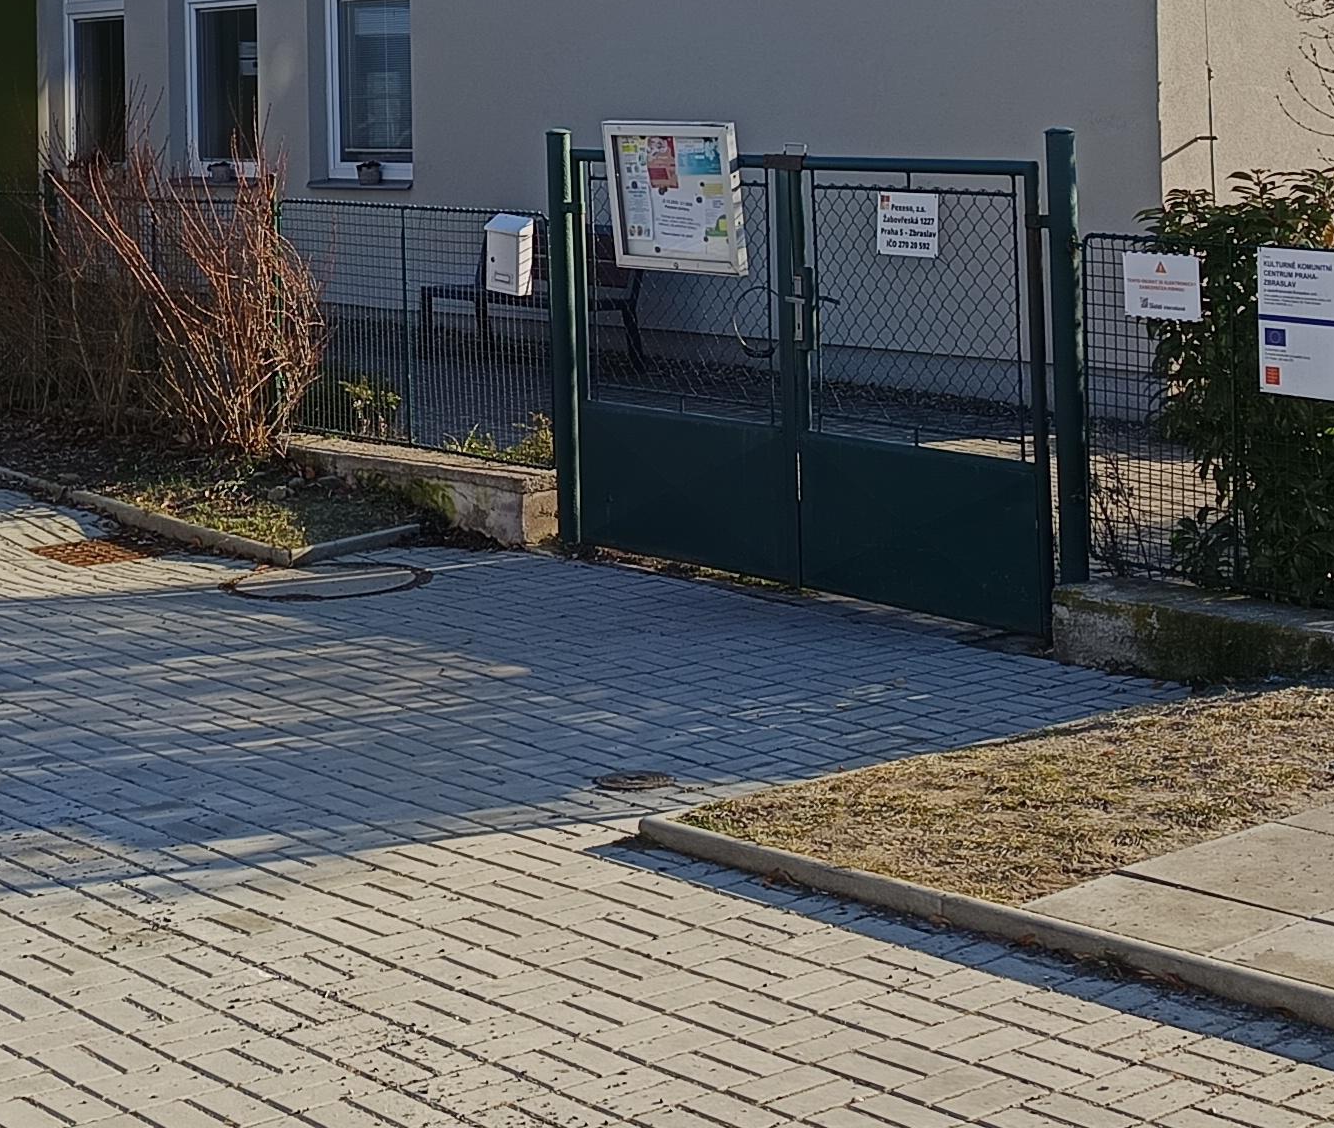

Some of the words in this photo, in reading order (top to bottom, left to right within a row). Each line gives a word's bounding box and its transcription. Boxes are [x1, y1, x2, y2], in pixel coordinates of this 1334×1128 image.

[909, 229, 936, 238] Zbraslav
[886, 238, 897, 248] IČO
[1263, 269, 1293, 278] CENTRUM
[1263, 278, 1296, 287] ZBRASLAV
